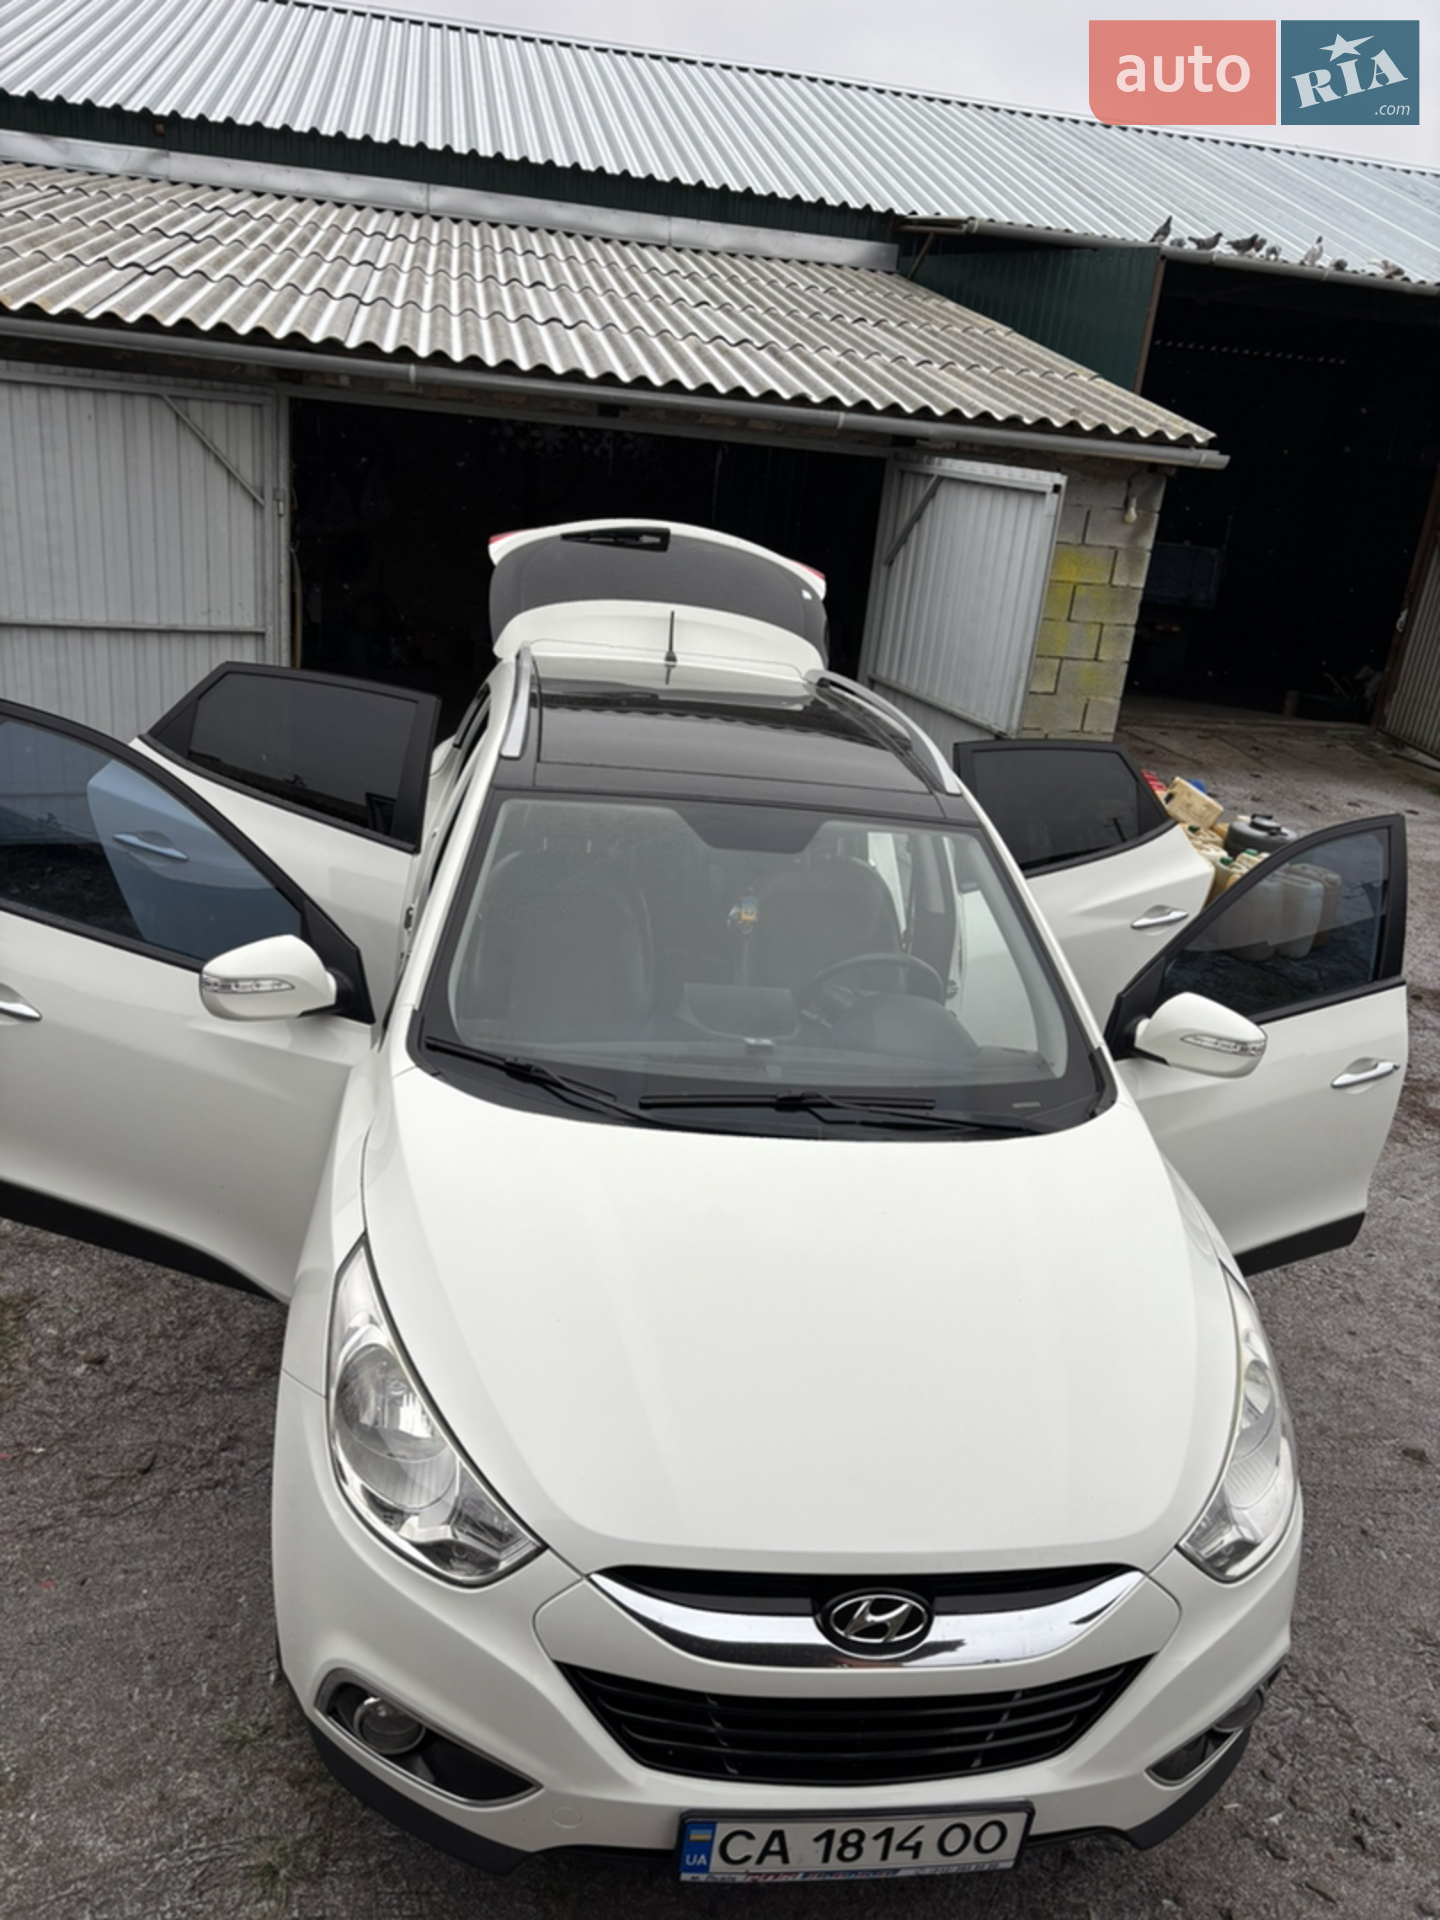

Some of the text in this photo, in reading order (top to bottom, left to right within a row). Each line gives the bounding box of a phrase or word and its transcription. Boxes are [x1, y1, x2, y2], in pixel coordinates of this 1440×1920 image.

[718, 1819, 1008, 1866] CA 1814 OO
[685, 1853, 708, 1867] UA
